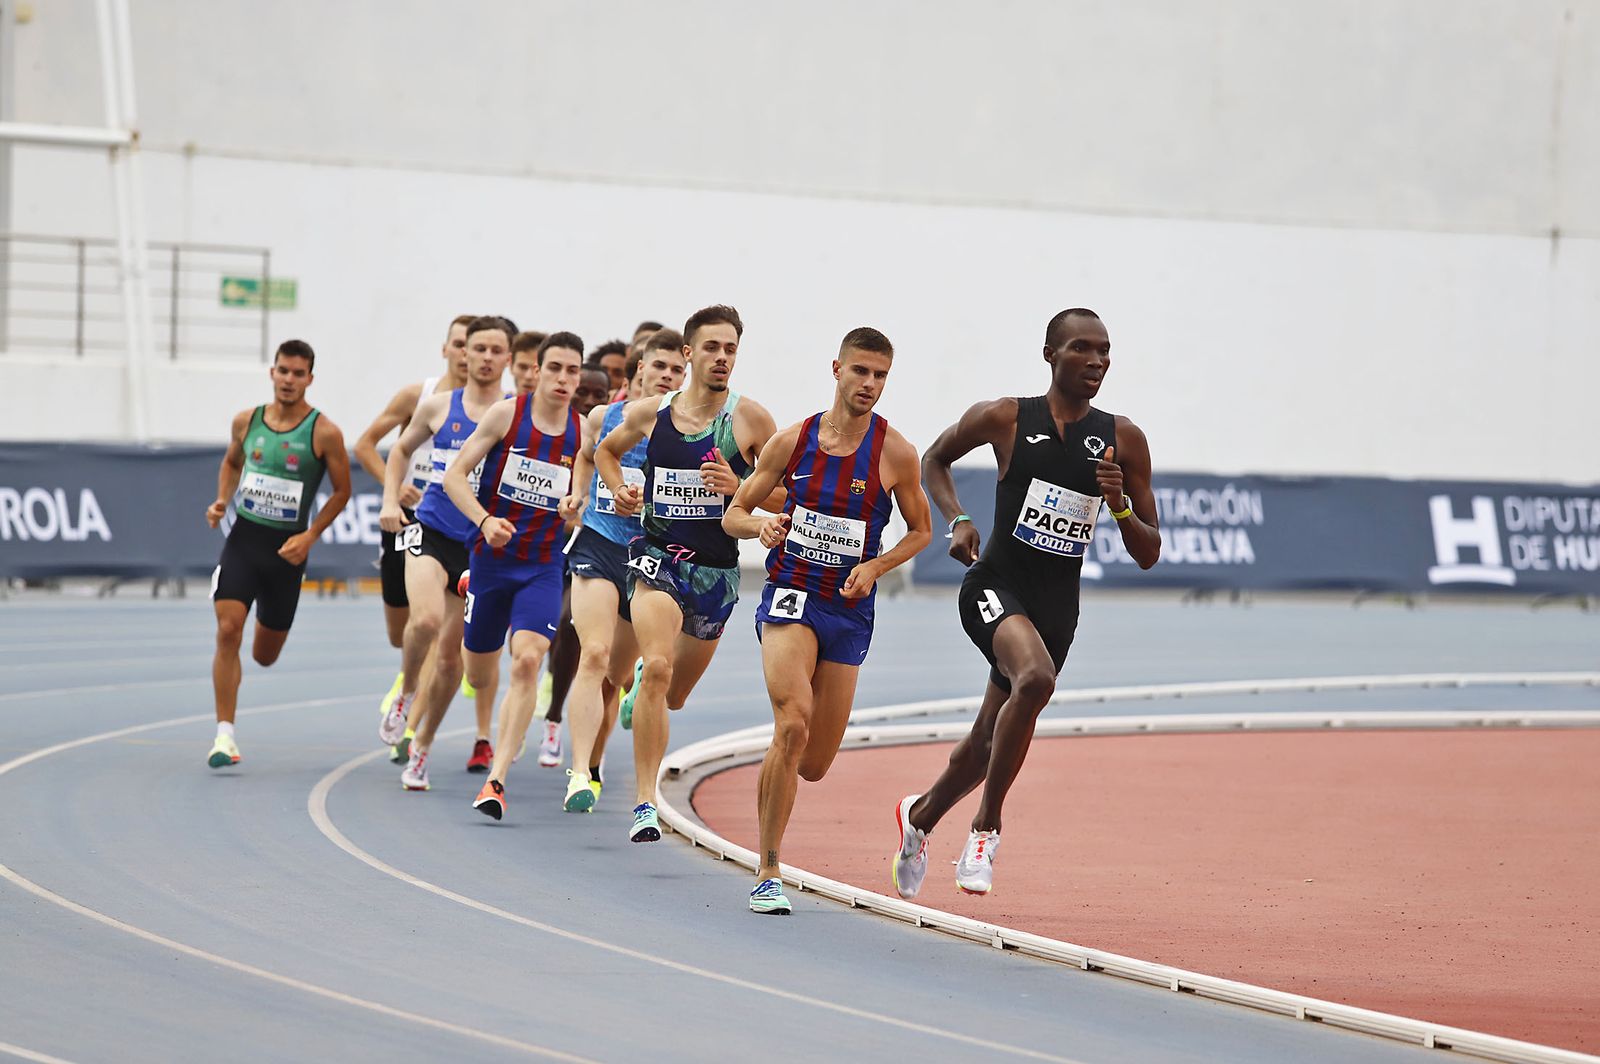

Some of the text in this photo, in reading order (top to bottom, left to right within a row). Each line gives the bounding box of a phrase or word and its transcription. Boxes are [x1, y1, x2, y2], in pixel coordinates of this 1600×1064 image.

[517, 472, 553, 489] MOYA
[656, 485, 718, 498] PEREIRA
[793, 523, 861, 548] VALLADARES
[1023, 507, 1092, 540] PACER
[818, 541, 830, 550] 29
[1158, 527, 1255, 564] UELVA
[1509, 534, 1550, 571] DE
[775, 592, 798, 615] 4
